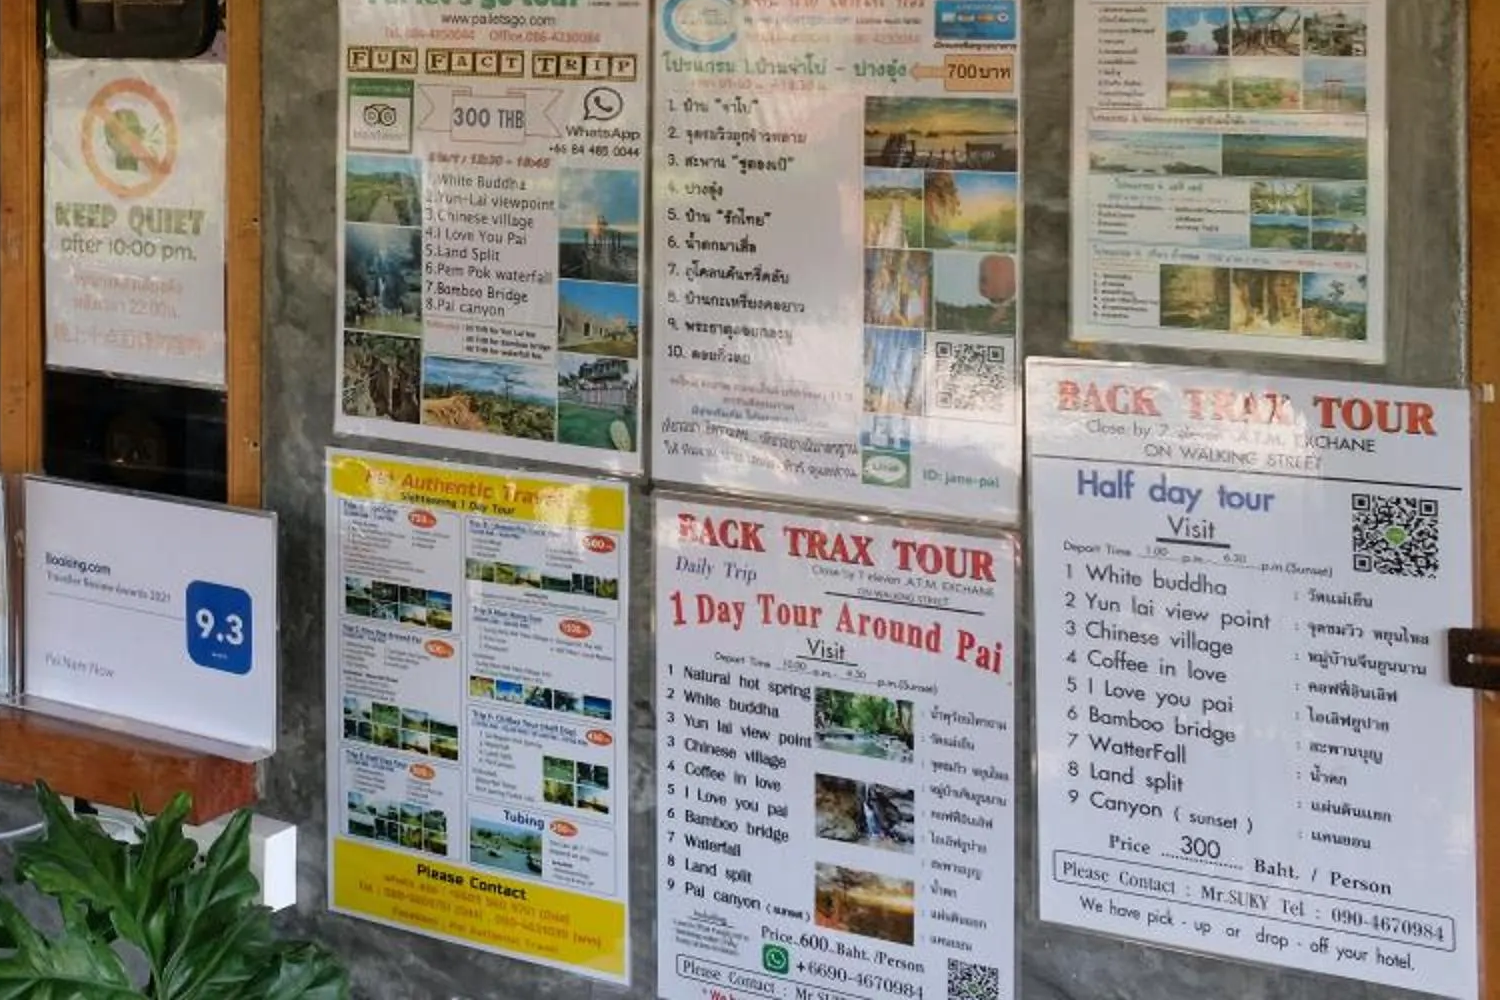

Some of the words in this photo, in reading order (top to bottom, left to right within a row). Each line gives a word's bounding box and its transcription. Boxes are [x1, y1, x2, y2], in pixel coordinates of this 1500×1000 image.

[350, 51, 413, 67] FUN
[431, 51, 518, 69] FACT
[535, 56, 631, 75] TRIP
[454, 108, 490, 127] 300
[499, 110, 524, 128] THB
[566, 125, 641, 141] WhatsApp
[55, 202, 117, 229] KEEP
[128, 205, 206, 237] QUIET
[61, 236, 103, 253] after
[109, 238, 156, 259] 10:00
[472, 247, 500, 262] Split
[487, 285, 528, 304] Bridge
[460, 302, 505, 318] canyon
[1314, 396, 1437, 436] TOUR
[1145, 444, 1172, 458] ON
[401, 473, 493, 500] Authentic
[1078, 469, 1135, 497] Half
[1149, 478, 1203, 513] day
[1218, 484, 1274, 512] tour
[1168, 515, 1216, 540] Visit
[783, 526, 874, 567] TRAX
[892, 538, 996, 582] TOUR
[675, 556, 715, 577] Daily
[724, 562, 757, 585] Trip
[1086, 565, 1142, 587] White
[1153, 572, 1227, 597] buddha
[196, 609, 244, 646] 9.3
[670, 591, 686, 626] 1
[696, 594, 745, 630] Day
[758, 594, 822, 628] Tour
[836, 602, 942, 653] Around
[957, 629, 1002, 674] Pai
[1167, 604, 1208, 622] view
[1221, 609, 1270, 634] point
[806, 638, 845, 660] Visit
[1085, 620, 1160, 647] Chinese
[1171, 628, 1233, 657] village
[1088, 649, 1148, 675] Coffee
[1188, 661, 1227, 684] love
[684, 664, 731, 686] Natural
[739, 674, 759, 691] hot
[768, 680, 811, 702] spring
[1105, 680, 1146, 701] Love
[1156, 688, 1191, 709] you
[1203, 694, 1233, 716] pai
[729, 697, 779, 719] buddha
[740, 725, 769, 741] view
[778, 730, 812, 749] point
[1089, 706, 1164, 733] Bamboo
[1175, 713, 1236, 744] bridge
[684, 738, 736, 760] Chinese
[745, 747, 786, 769] village
[1089, 734, 1187, 764] WatterFall
[684, 762, 725, 782] Coffee
[756, 774, 781, 792] love
[1090, 762, 1134, 785] Land
[1146, 771, 1183, 794] split
[503, 809, 545, 831] Tubing
[1090, 791, 1162, 820] Canyon
[1190, 811, 1238, 830] sunset
[685, 809, 738, 832] Bamboo
[747, 822, 788, 843] bridge
[684, 832, 741, 857] Waterfall
[685, 858, 717, 878] Land
[1109, 834, 1151, 856] Price
[1330, 870, 1392, 895] Person
[417, 864, 464, 886] Please
[470, 877, 526, 901] Contact
[713, 889, 761, 913] canyon
[1063, 861, 1110, 882] Please
[1119, 871, 1175, 895] Contact
[1331, 907, 1444, 943] 090-4670984
[682, 960, 721, 982] Please
[729, 971, 774, 994] Contact
[796, 960, 923, 997] +6690-4670984
